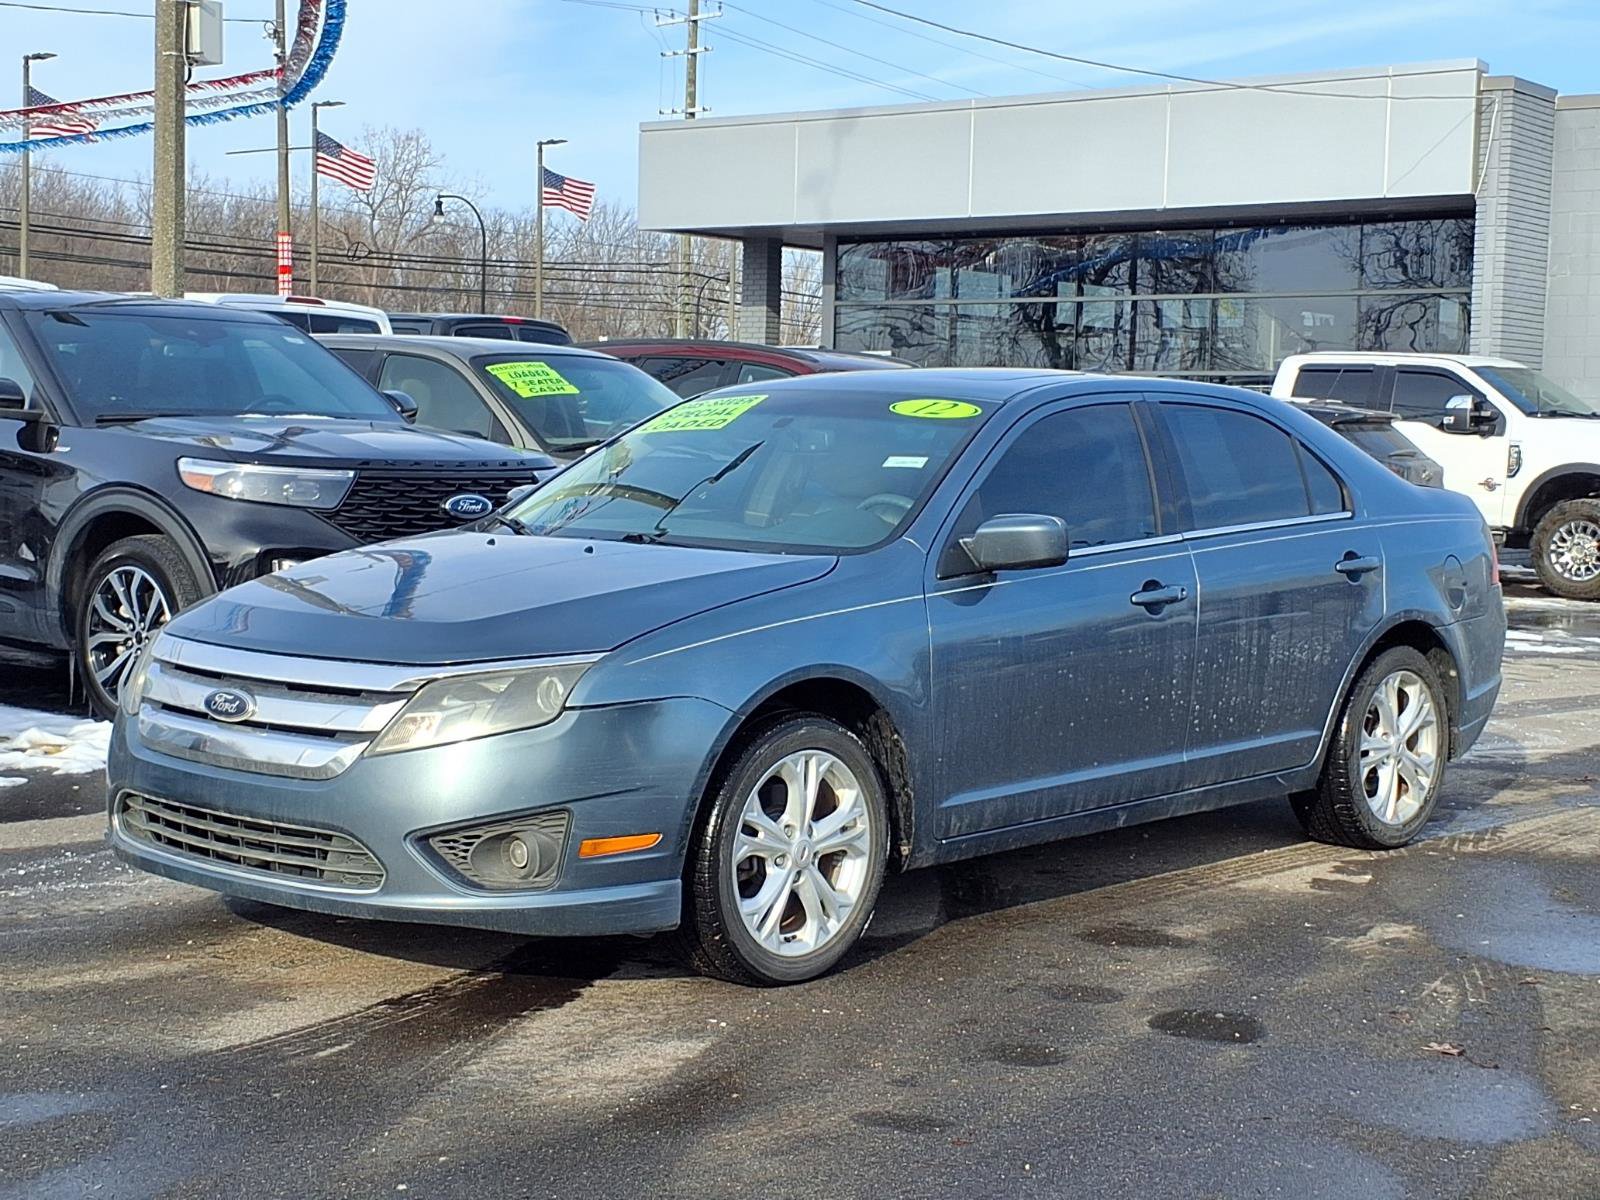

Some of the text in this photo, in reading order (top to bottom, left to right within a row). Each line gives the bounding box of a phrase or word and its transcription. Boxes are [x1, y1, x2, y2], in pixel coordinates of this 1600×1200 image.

[508, 370, 549, 379] LOADED
[522, 378, 564, 386] SEATER
[911, 402, 959, 415] 12
[457, 499, 483, 512] Ford
[210, 692, 240, 713] Ford
